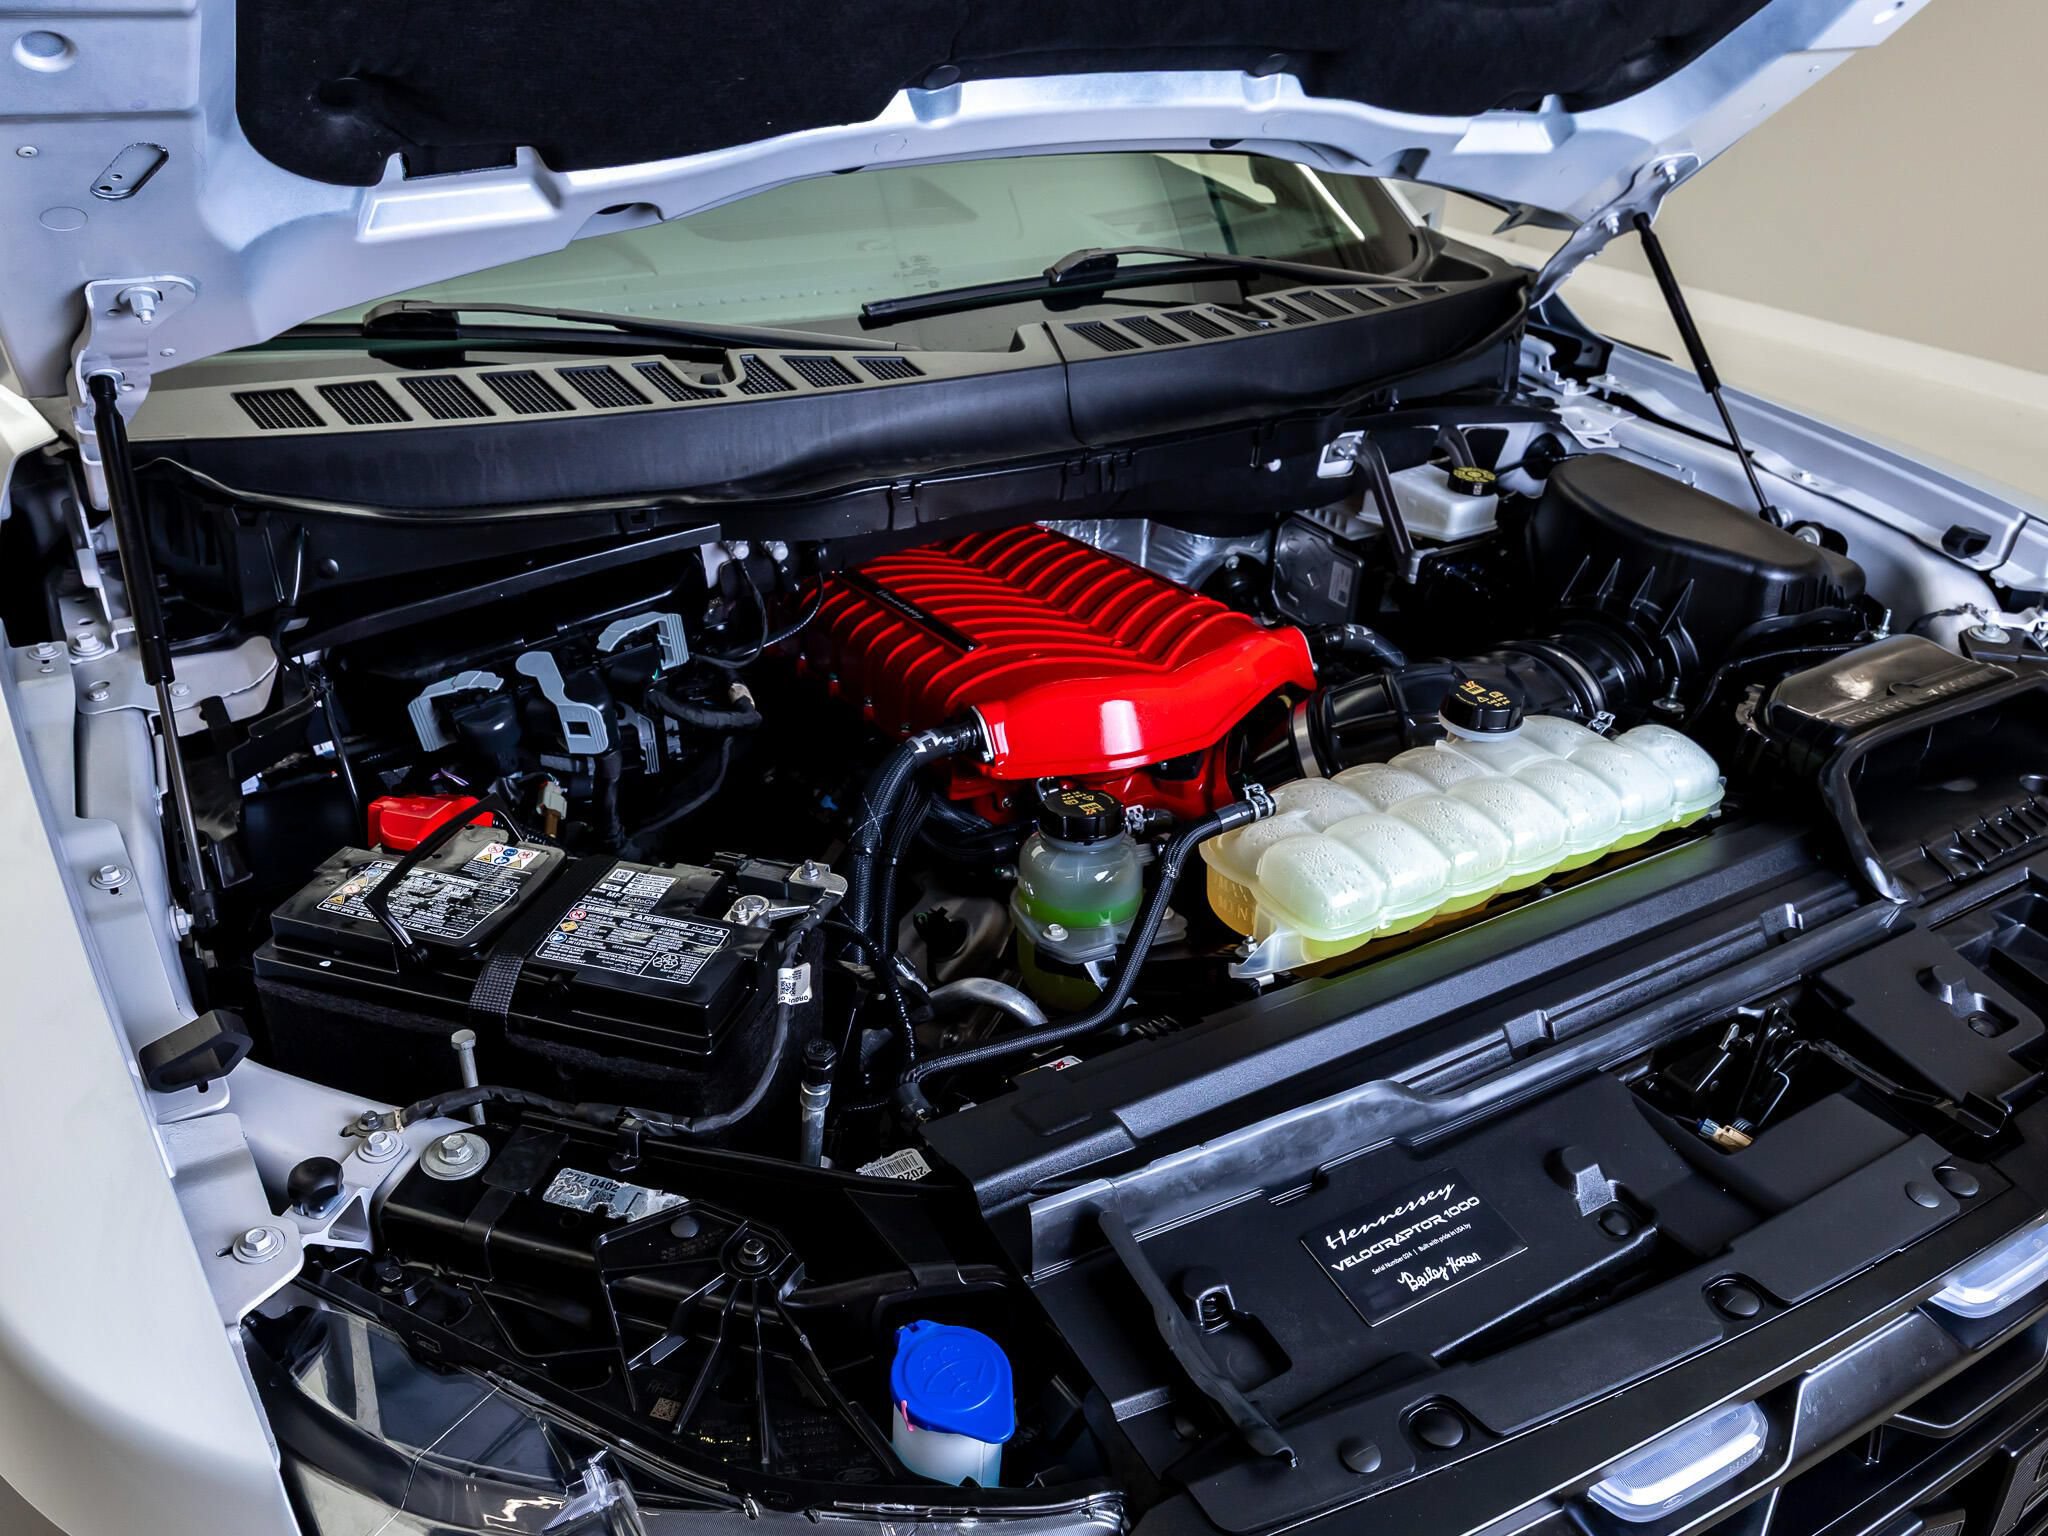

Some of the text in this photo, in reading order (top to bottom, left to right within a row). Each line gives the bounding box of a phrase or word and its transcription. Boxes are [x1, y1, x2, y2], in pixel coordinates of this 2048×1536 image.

[590, 1178, 620, 1193] 0402
[1325, 1183, 1455, 1250] Hennessey
[1331, 1196, 1481, 1272] VELOCIRAPTOR 1000
[1371, 1264, 1385, 1275] Serial
[1384, 1256, 1404, 1269] Number
[1418, 1243, 1430, 1252] Built
[1428, 1238, 1440, 1247] with
[1438, 1233, 1451, 1244] pride
[1454, 1224, 1466, 1234] USA
[1464, 1223, 1472, 1231] by
